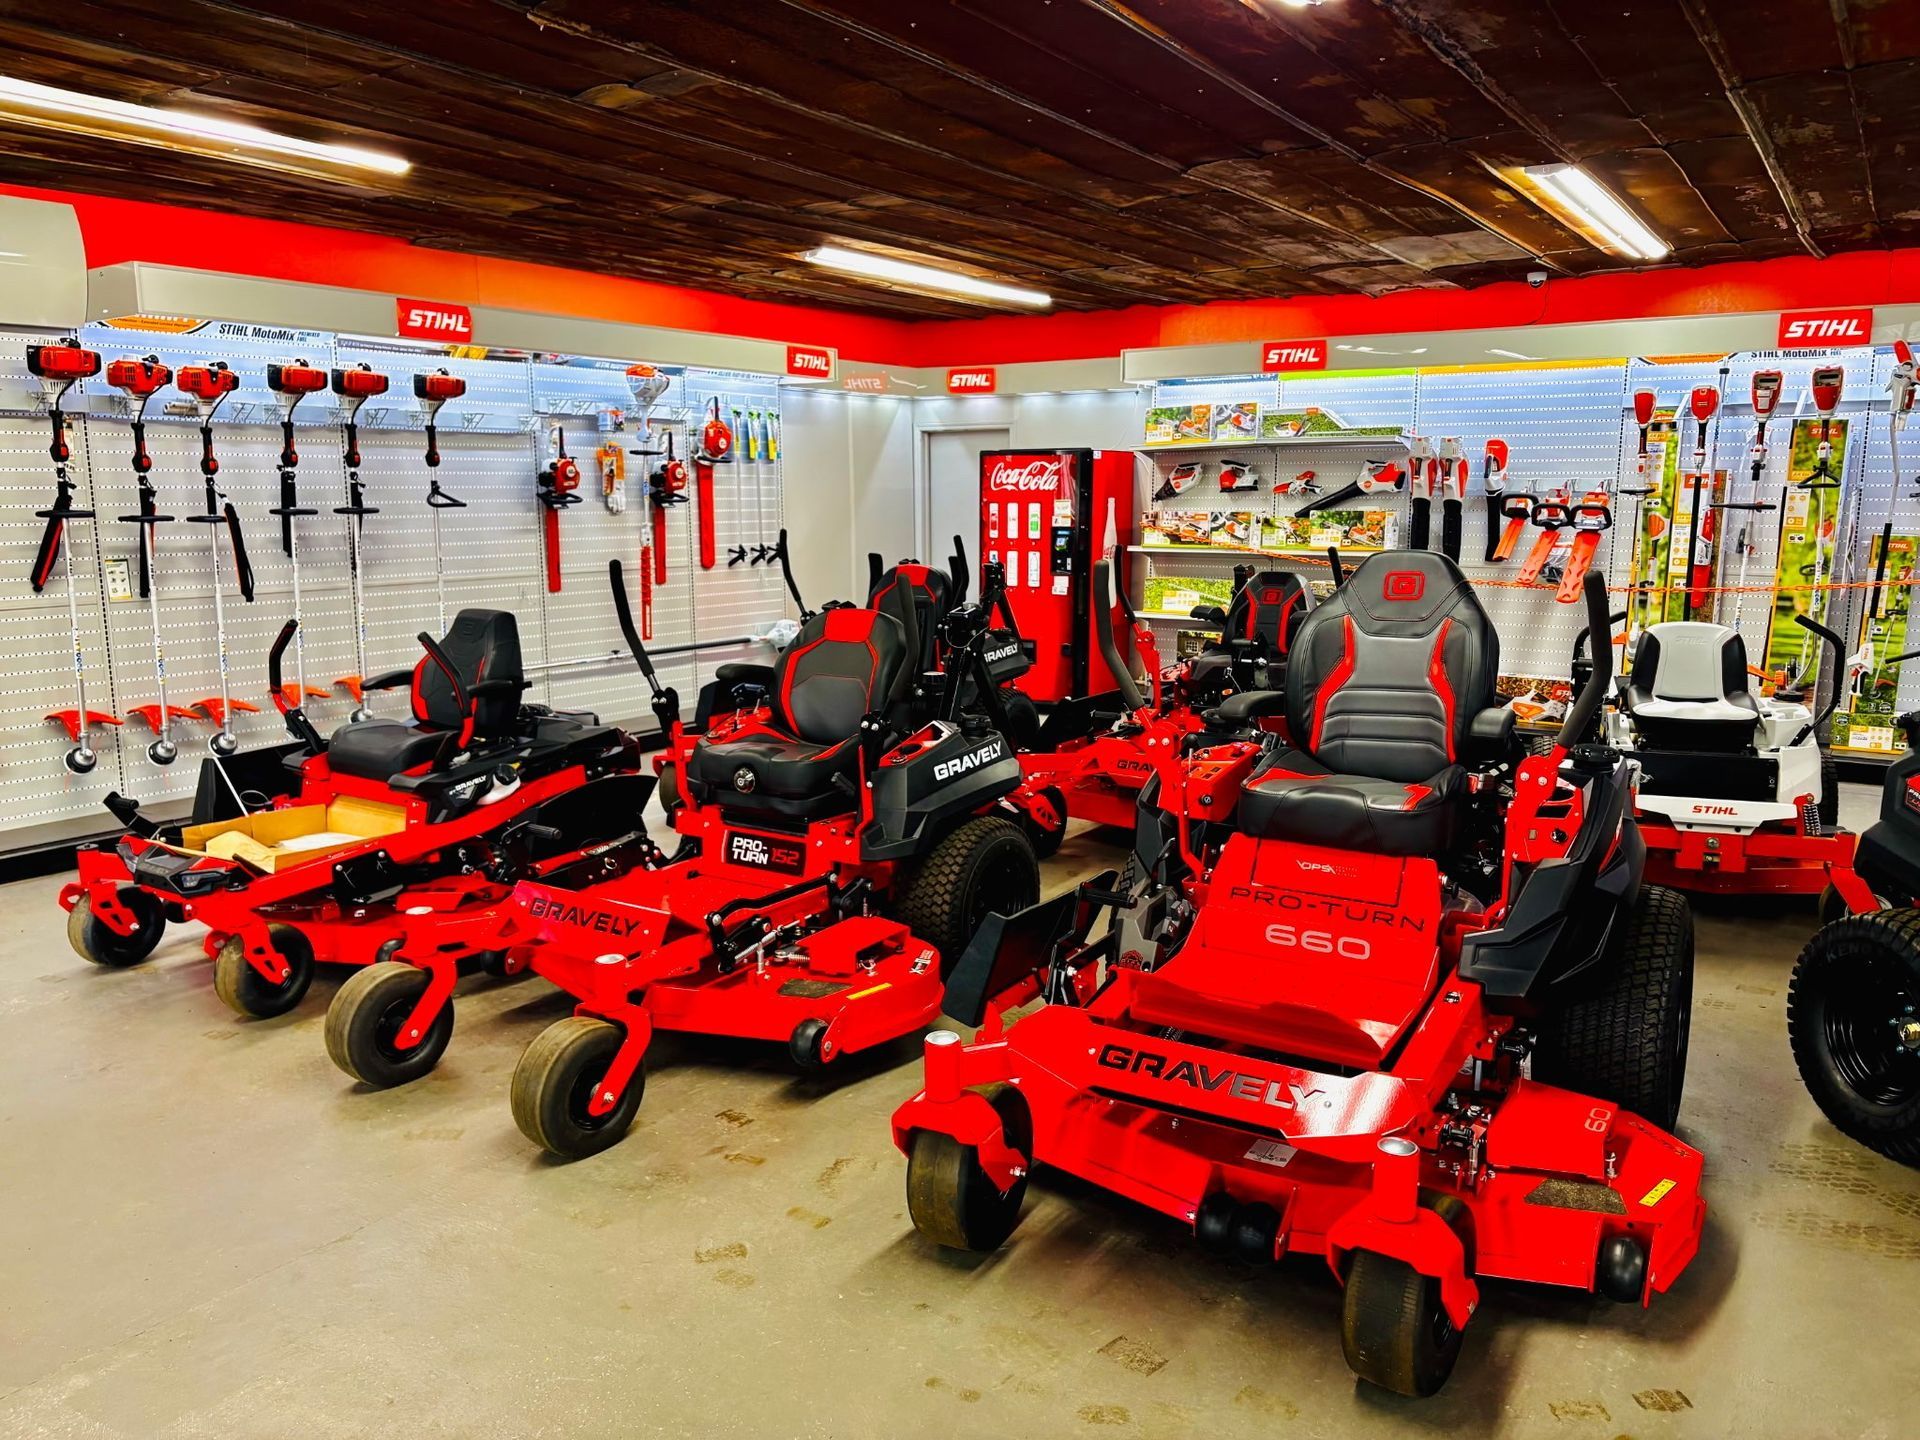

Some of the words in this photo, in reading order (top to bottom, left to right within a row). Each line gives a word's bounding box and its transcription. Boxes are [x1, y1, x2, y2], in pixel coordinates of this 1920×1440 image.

[407, 309, 470, 332] STIHL
[1783, 319, 1864, 338] STIHL
[219, 323, 249, 337] STIHL
[251, 326, 296, 341] MotoMix
[793, 352, 829, 371] STIHL
[1266, 348, 1320, 364] STIHL
[1751, 350, 1780, 358] STIHL
[1782, 348, 1828, 358] MotoMix
[949, 373, 991, 387] STIHL
[933, 740, 1001, 781] GRAVELY
[455, 775, 487, 791] GRAVELY
[1692, 805, 1738, 816] STIHL
[732, 836, 768, 852] PRO-
[731, 847, 769, 865] TURN
[771, 847, 800, 866] 152
[529, 898, 640, 937] GRAVELY
[1230, 887, 1425, 932] PRO-TURN
[1265, 923, 1371, 961] 660
[1097, 1044, 1327, 1113] GRAVELY
[1584, 1107, 1612, 1133] 60
